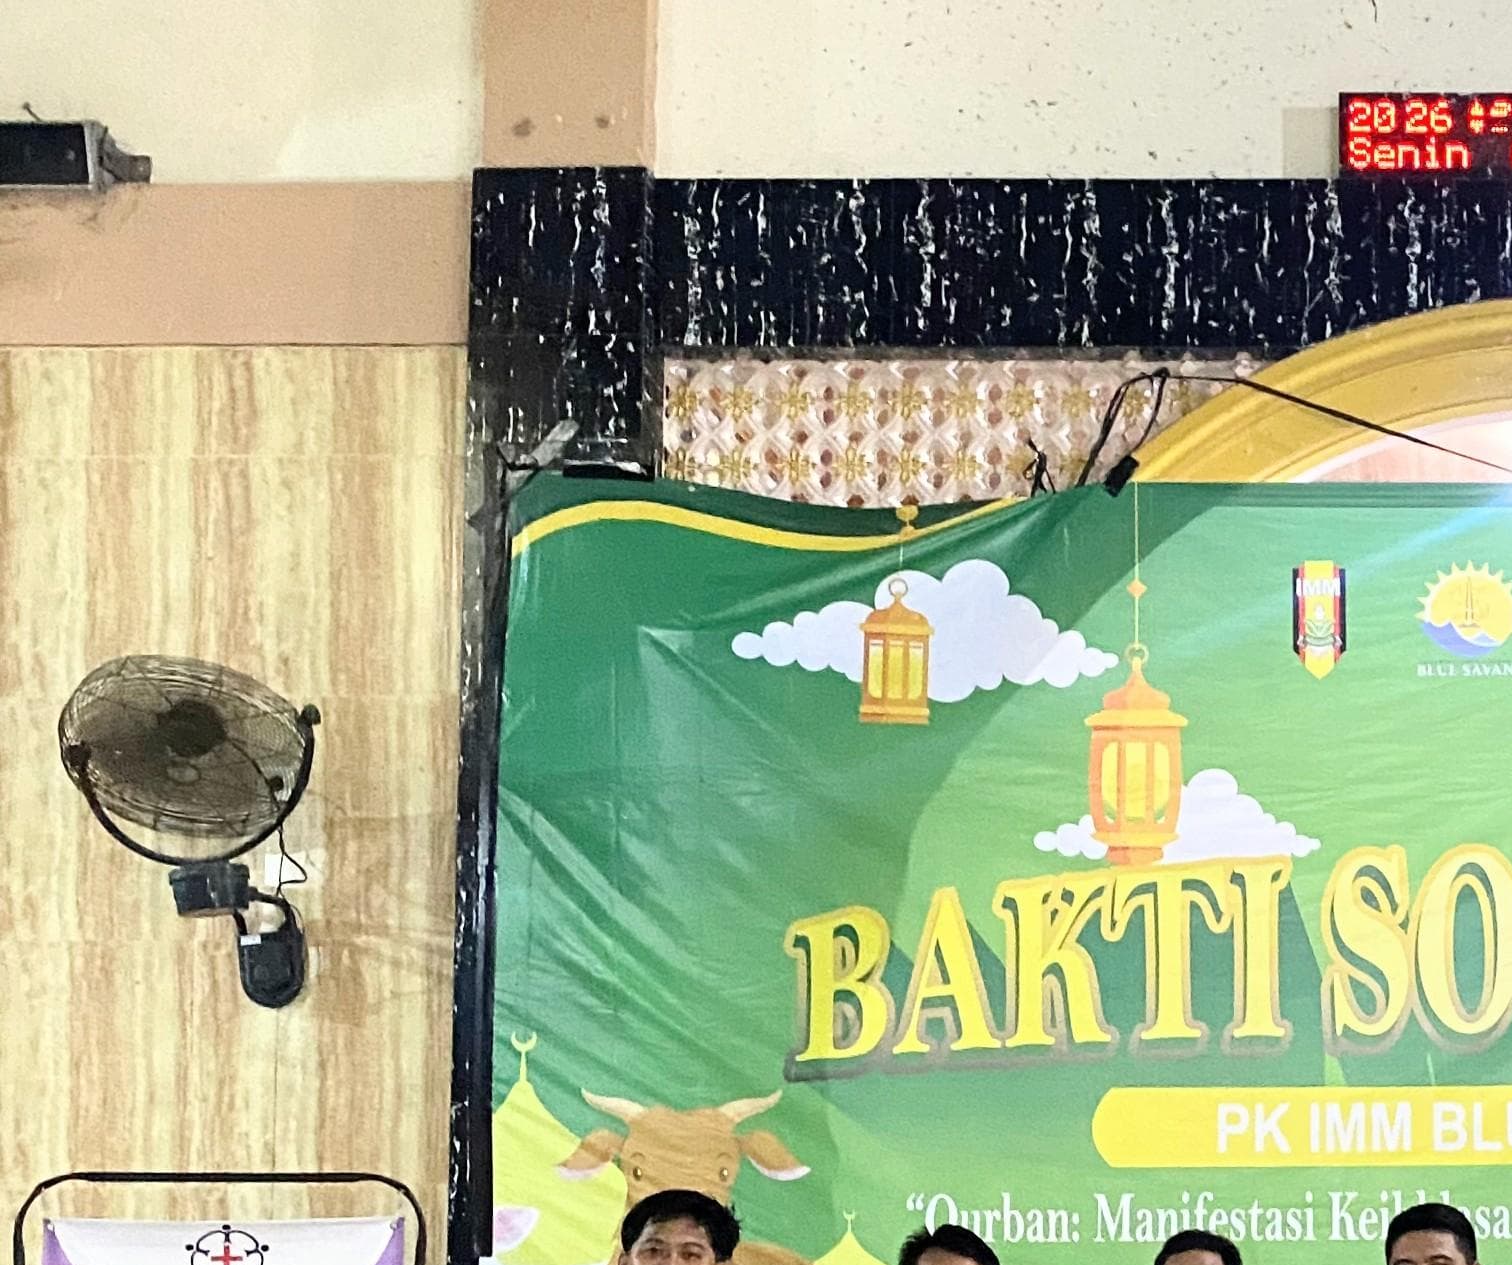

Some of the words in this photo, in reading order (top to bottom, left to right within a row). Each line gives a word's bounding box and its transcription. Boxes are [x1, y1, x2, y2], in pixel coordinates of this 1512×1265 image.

[1348, 136, 1470, 170] Senin
[1296, 577, 1341, 598] IMM
[785, 857, 1292, 1066] BAKTI
[1217, 1101, 1292, 1153] PK
[1309, 1101, 1412, 1153] IMM
[1094, 1191, 1315, 1244] Manifestasi
